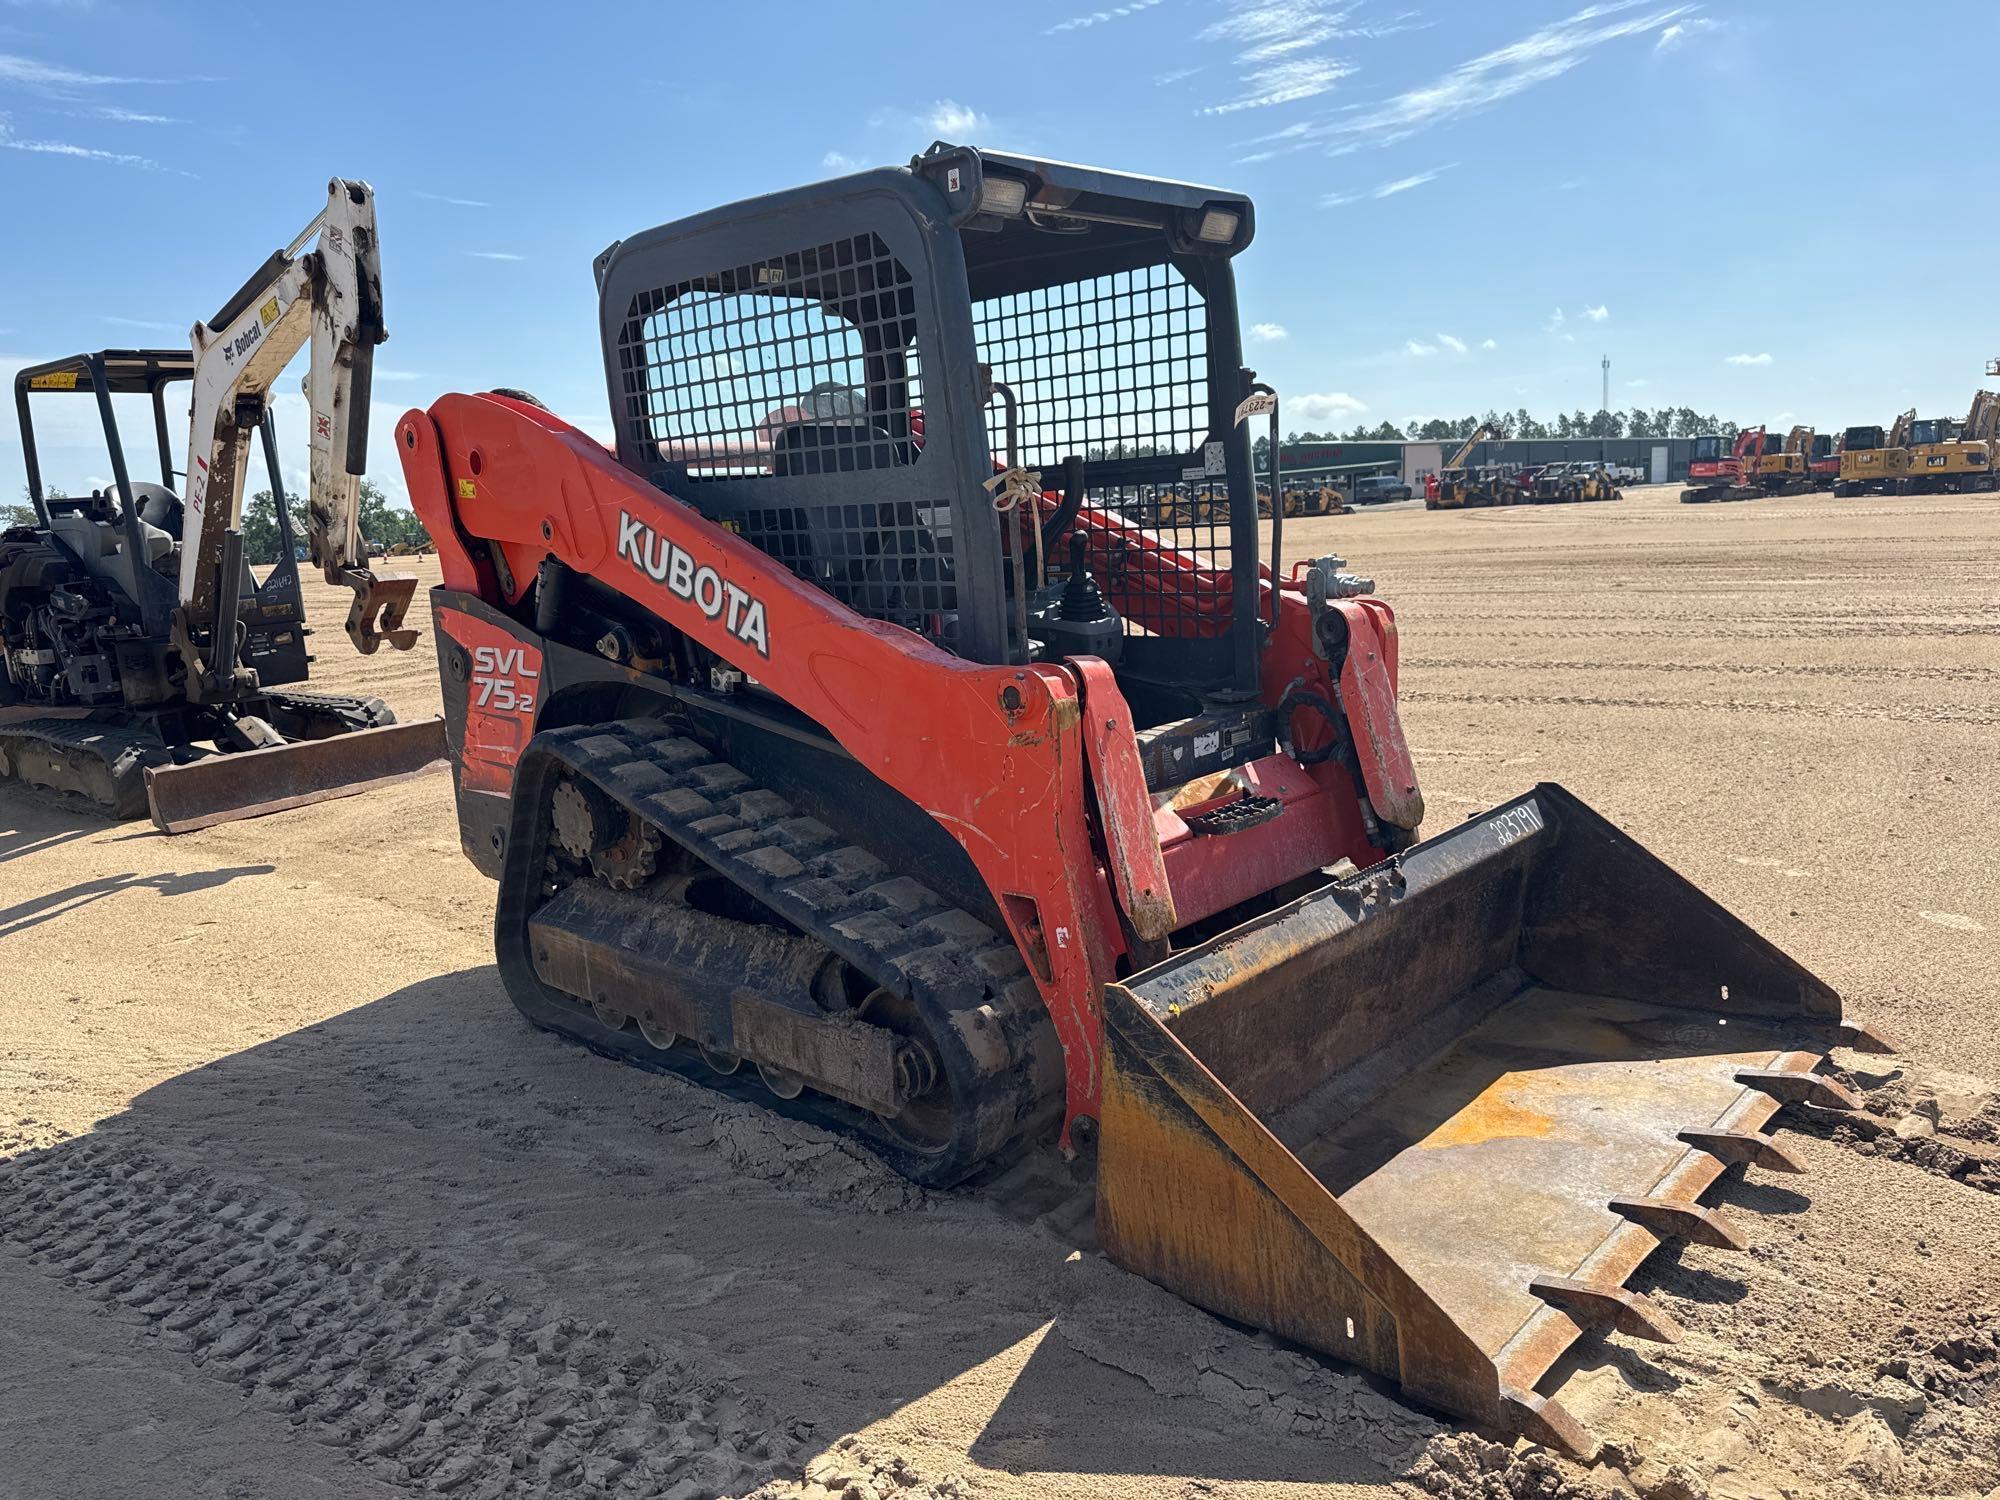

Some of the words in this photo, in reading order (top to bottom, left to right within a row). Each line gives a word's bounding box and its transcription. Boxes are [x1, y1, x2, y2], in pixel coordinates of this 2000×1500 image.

[234, 320, 262, 357] Bobcat
[1858, 454, 1873, 464] CAT
[617, 510, 769, 657] KUBOTA
[474, 646, 538, 678] SVL
[473, 676, 534, 713] 75-2
[1489, 805, 1544, 846] 223791
